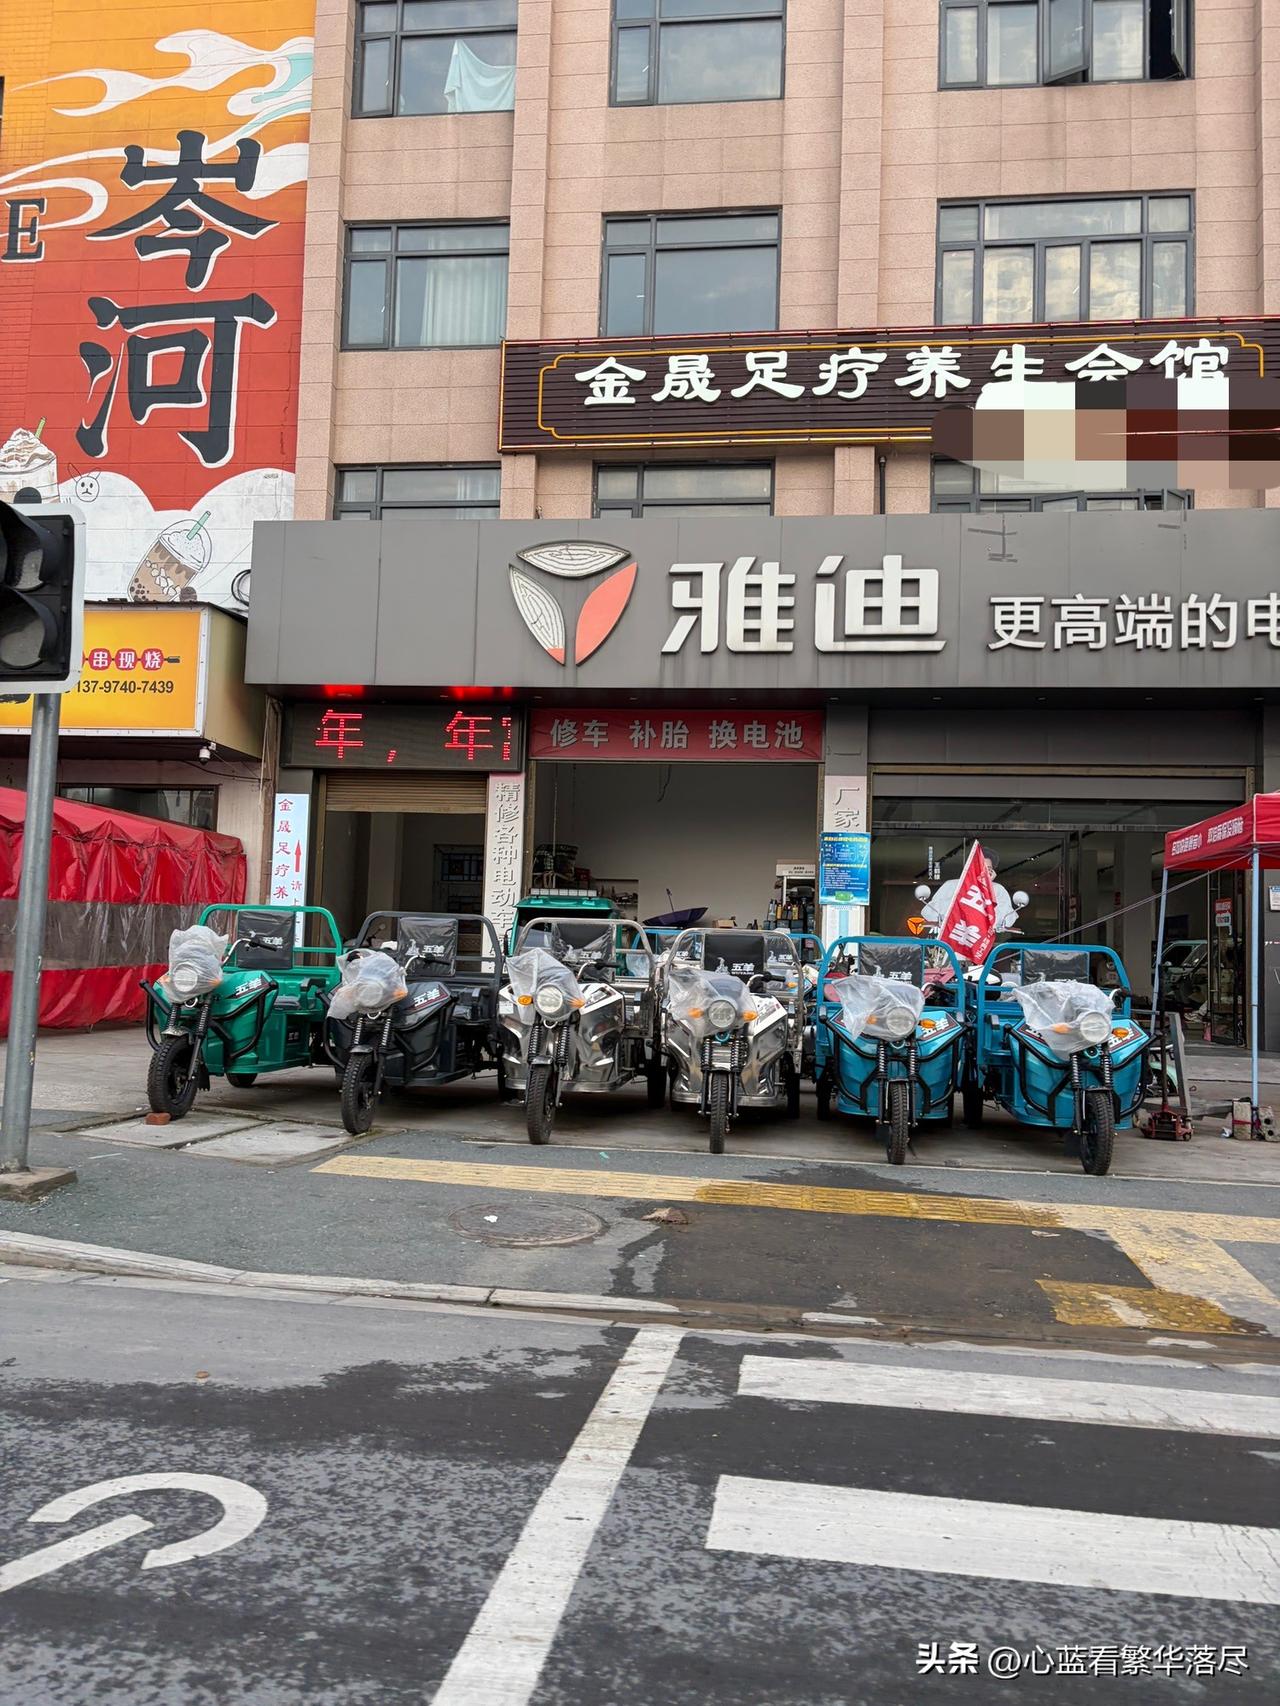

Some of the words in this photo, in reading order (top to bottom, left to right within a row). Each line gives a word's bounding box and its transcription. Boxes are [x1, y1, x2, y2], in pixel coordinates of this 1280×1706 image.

[1, 198, 46, 261] E
[76, 130, 281, 467] 岑河
[574, 338, 1230, 406] 金晟足疗养生会馆
[661, 555, 946, 654] 雅迪
[987, 592, 1280, 651] 更高端的电
[550, 719, 610, 748] 修车
[628, 720, 690, 749] 补胎
[708, 720, 804, 750] 换电池
[273, 799, 293, 899] 金晟足疗养
